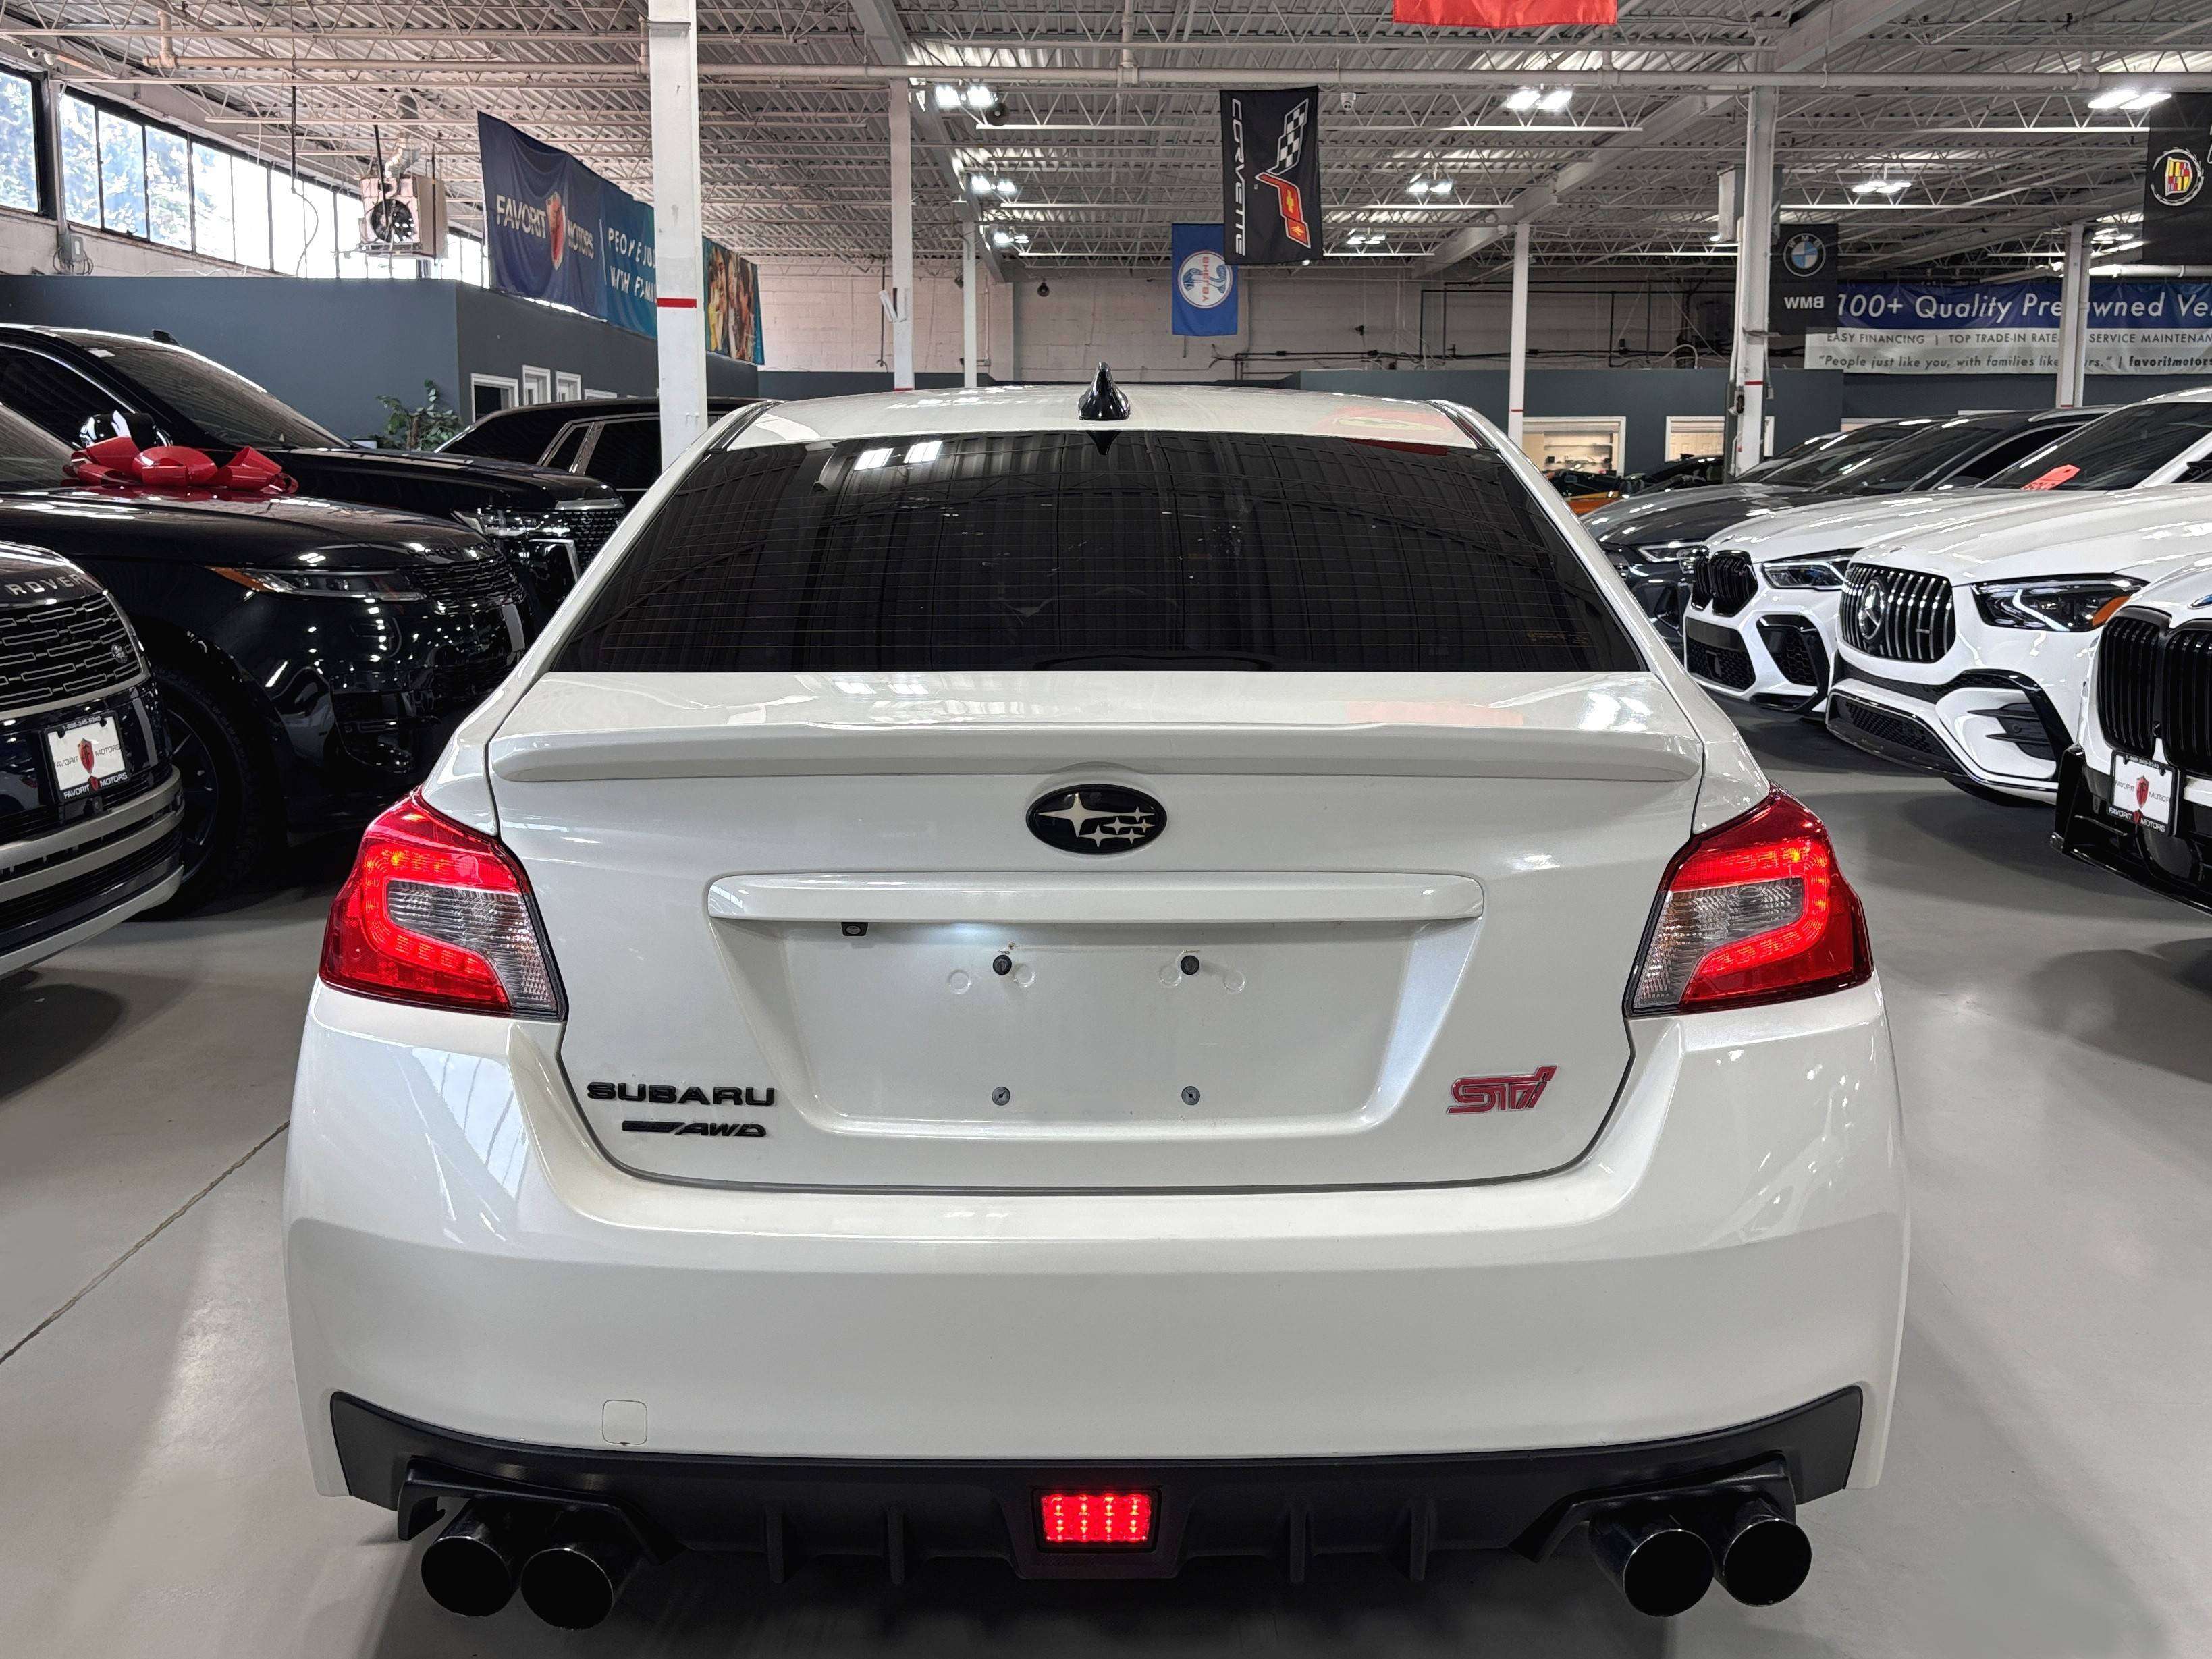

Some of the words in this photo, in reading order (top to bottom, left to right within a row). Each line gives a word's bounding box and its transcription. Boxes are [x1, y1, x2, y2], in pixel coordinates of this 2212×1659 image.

[1232, 98, 1246, 256] CORVETTE
[497, 194, 547, 238] FAVORIT
[1837, 293, 1904, 317] 100+
[1915, 292, 2012, 323] Quality
[2177, 293, 2212, 317] Ve
[1827, 333, 1855, 343] EASY
[1859, 333, 1925, 344] FINANCING
[1949, 334, 1971, 344] TOP
[1976, 333, 2026, 344] TRADE-IN
[2032, 333, 2060, 344] RATE
[2089, 333, 2136, 344] SERVICE
[1870, 356, 1894, 369] just
[1898, 356, 1921, 367] like
[1925, 357, 1951, 369] you,
[1956, 356, 1982, 367] with
[1987, 355, 2034, 368] families
[2039, 355, 2059, 366] like
[4, 574, 83, 595] ROVER
[63, 784, 90, 800] FAVORIT
[99, 772, 128, 788] MOTORS
[2108, 807, 2133, 821] FAVORIT
[2140, 817, 2165, 833] MOTORS
[587, 1081, 776, 1106] SUBARU
[674, 1122, 767, 1137] AWD
